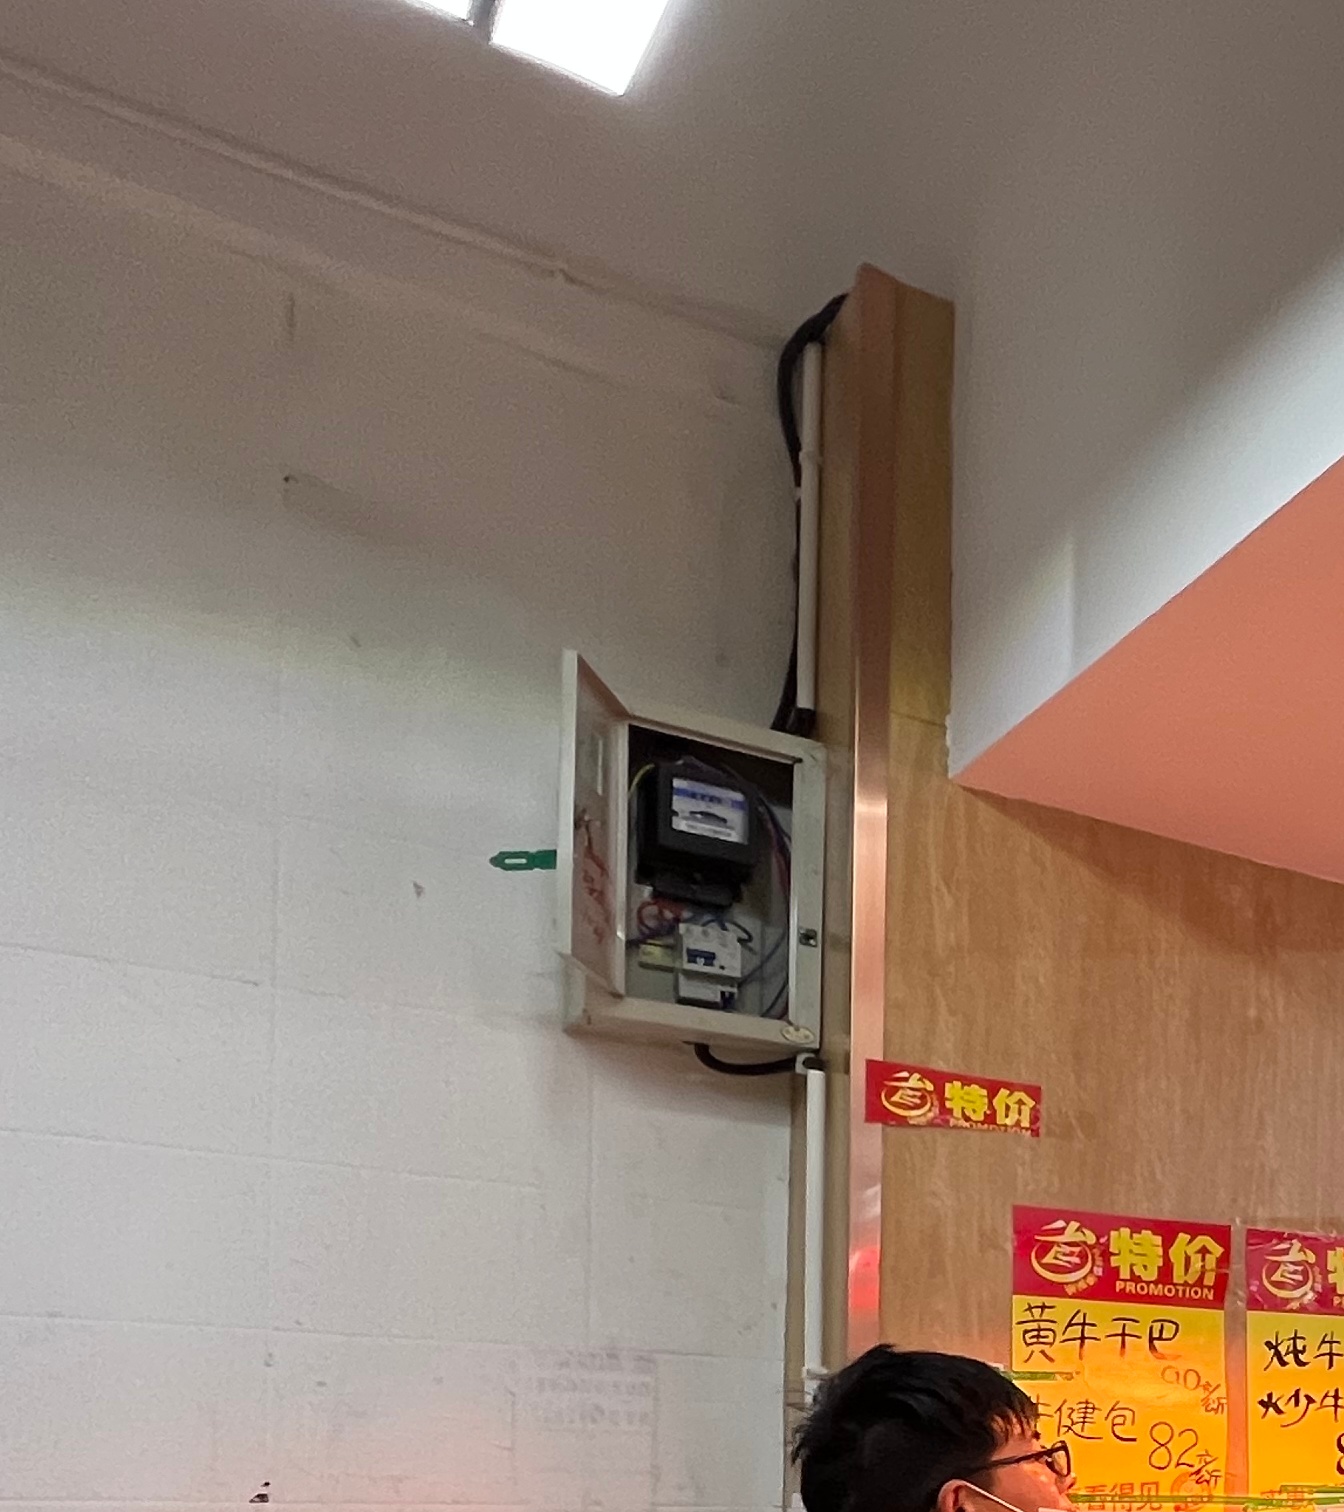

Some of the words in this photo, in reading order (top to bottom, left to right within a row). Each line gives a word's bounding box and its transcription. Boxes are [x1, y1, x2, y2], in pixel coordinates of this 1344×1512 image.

[945, 1080, 1036, 1128] 特价
[1108, 1226, 1225, 1286] 特价
[1115, 1280, 1215, 1300] PROMOTION
[1015, 1301, 1183, 1364] 黄牛干巴
